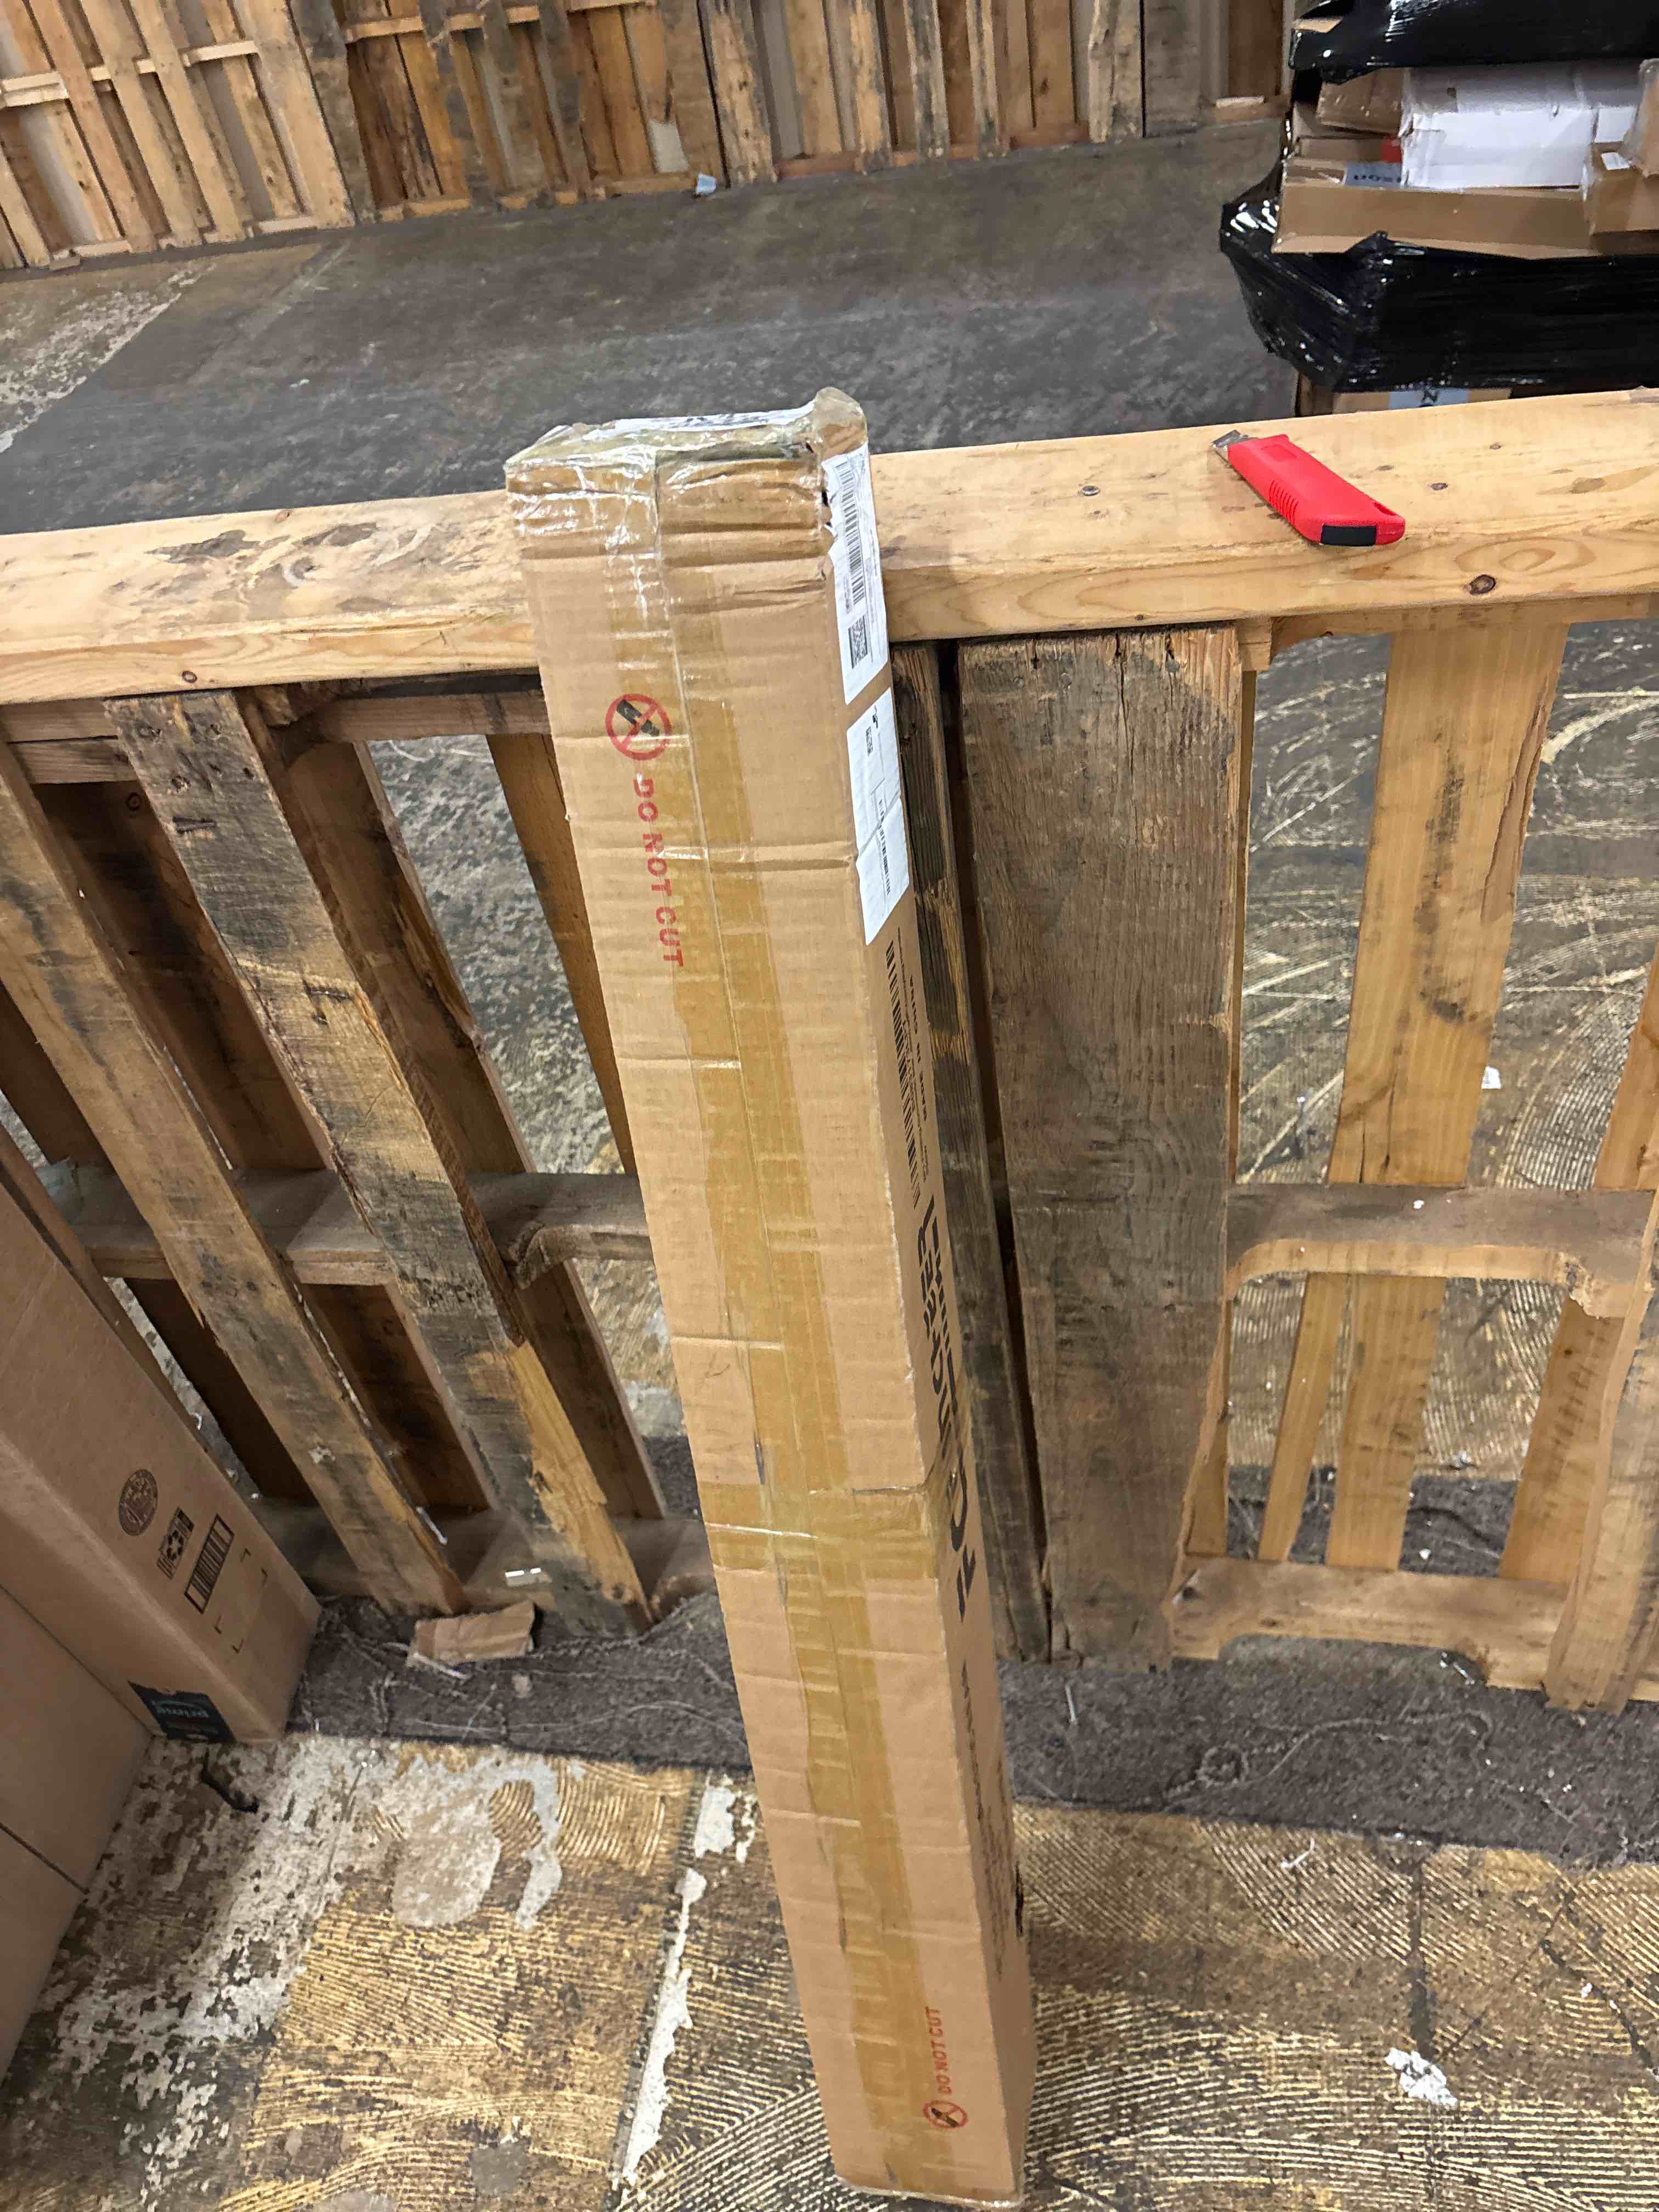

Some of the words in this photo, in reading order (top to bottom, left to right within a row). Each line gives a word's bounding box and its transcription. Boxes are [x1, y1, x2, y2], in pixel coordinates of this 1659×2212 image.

[633, 778, 659, 822] DO
[642, 833, 673, 897] NOT
[655, 906, 684, 967] CUT
[925, 2006, 943, 2036] CUT
[930, 2039, 949, 2071] NOT
[936, 2074, 952, 2094] DO
